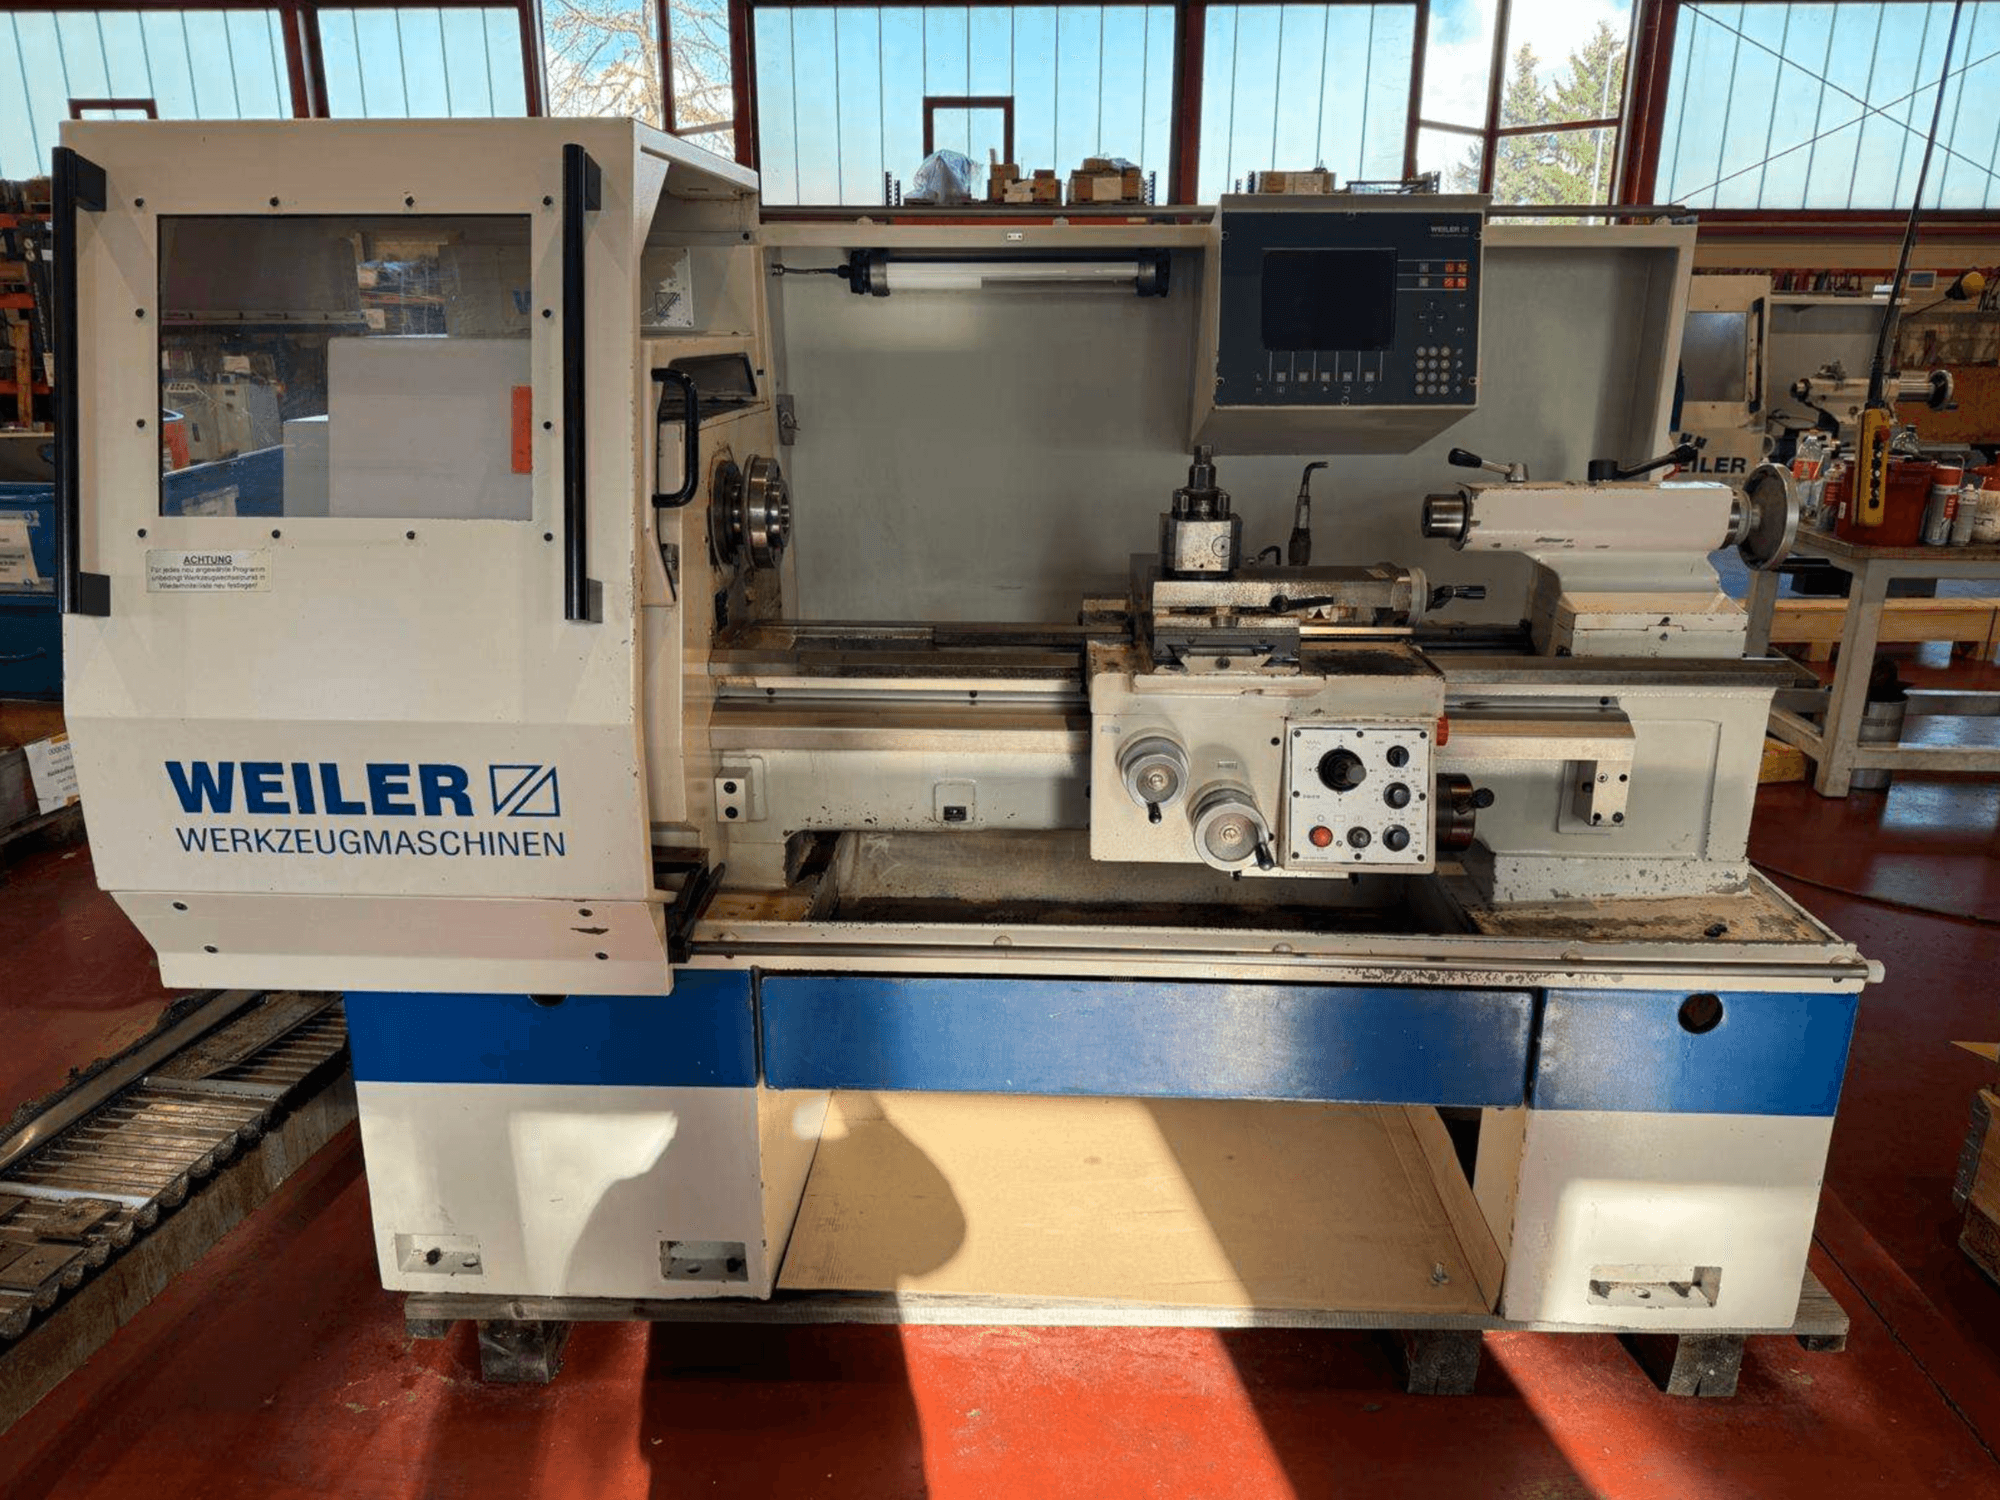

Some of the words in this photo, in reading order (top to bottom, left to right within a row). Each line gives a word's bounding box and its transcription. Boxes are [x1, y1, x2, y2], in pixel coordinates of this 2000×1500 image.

[183, 555, 233, 565] ACHTUNG
[232, 566, 265, 574] Programm
[164, 761, 475, 817] WEILER
[175, 827, 566, 857] WERKZEUGMASCHINEN
